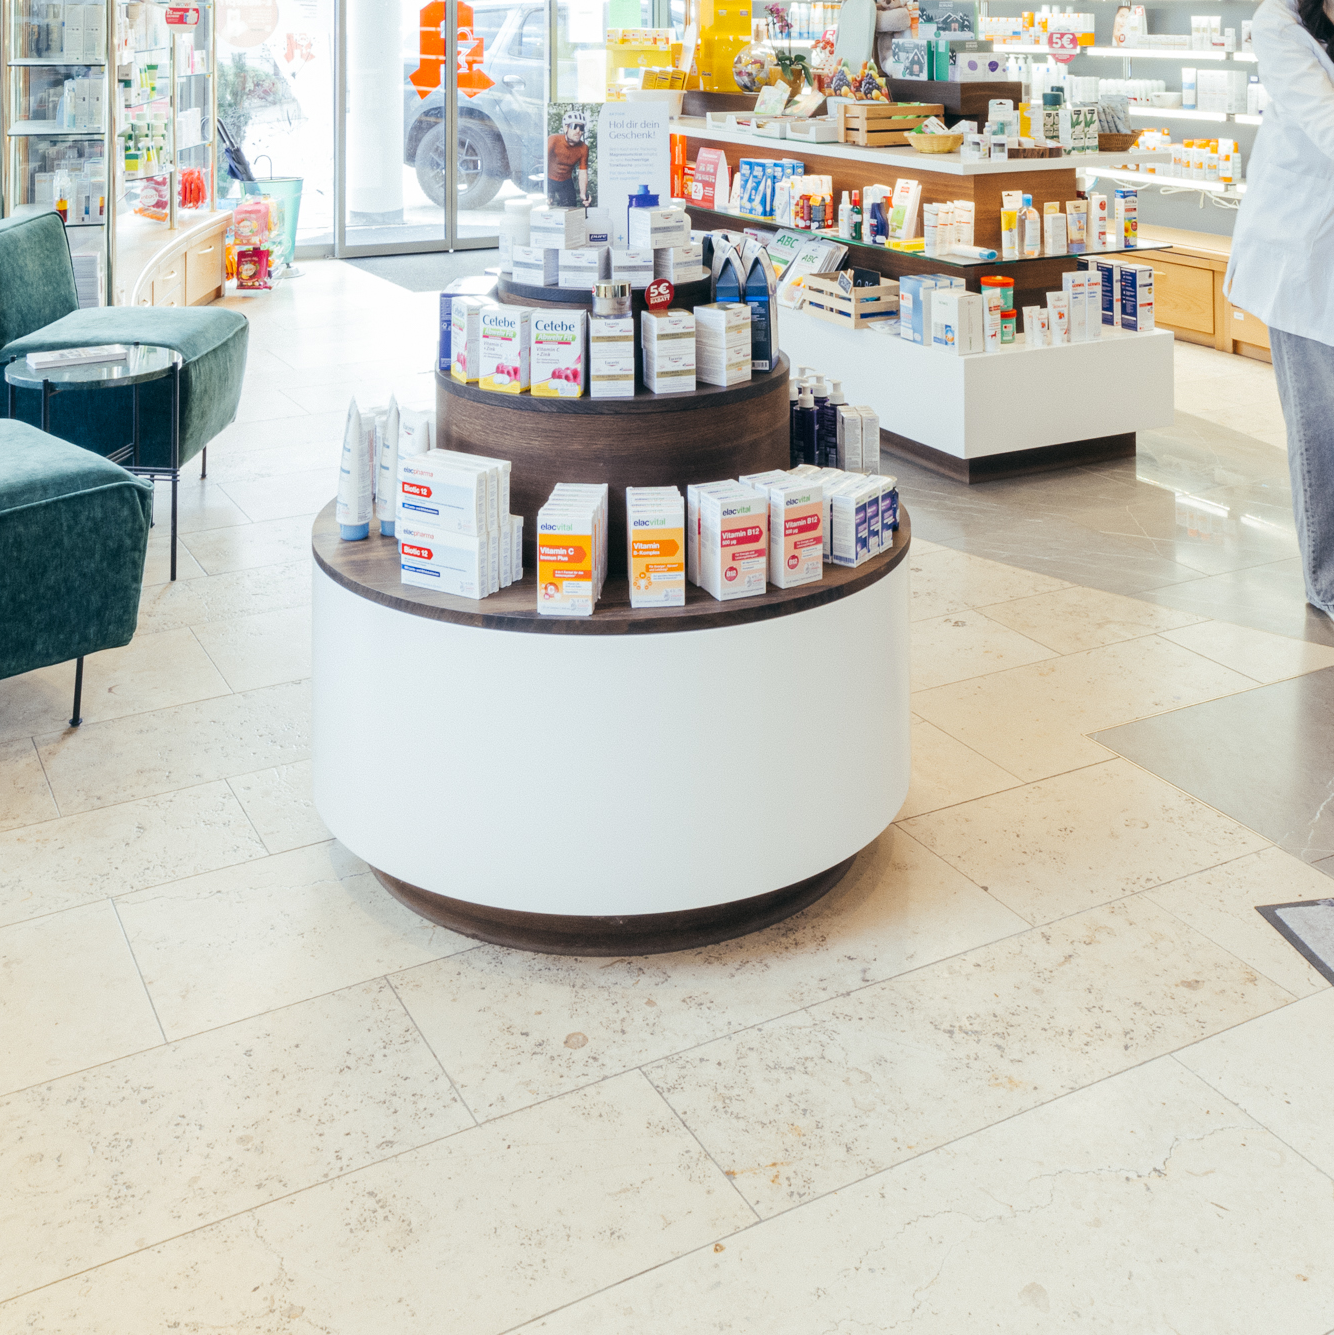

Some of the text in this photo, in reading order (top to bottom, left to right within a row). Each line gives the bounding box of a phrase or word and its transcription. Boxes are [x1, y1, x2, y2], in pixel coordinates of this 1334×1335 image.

[1052, 34, 1074, 49] 5€
[609, 120, 660, 128] Hol dir dein
[609, 131, 655, 139] Geschenk!
[776, 234, 799, 249] ABC
[801, 254, 819, 264] ABC
[649, 282, 670, 297] 5€
[650, 294, 671, 305] RABATT
[482, 314, 517, 329] Cetebe
[535, 319, 576, 332] Cetebe
[563, 334, 574, 342] Fit
[403, 466, 434, 478] elacpharma
[404, 484, 428, 496] Biotic 12
[786, 494, 811, 507] elacvital
[722, 505, 751, 516] elacvital
[541, 523, 573, 532] elacvital
[634, 518, 666, 527] elacvital
[785, 516, 818, 529] Vitamin B12
[403, 528, 435, 540] elacpharma
[722, 528, 760, 540] Vitamin B12
[540, 547, 575, 556] Vitamin C
[633, 542, 660, 550] Vitamin
[403, 546, 429, 558] Biotic 12
[788, 558, 799, 566] B12
[726, 570, 737, 578] B12
